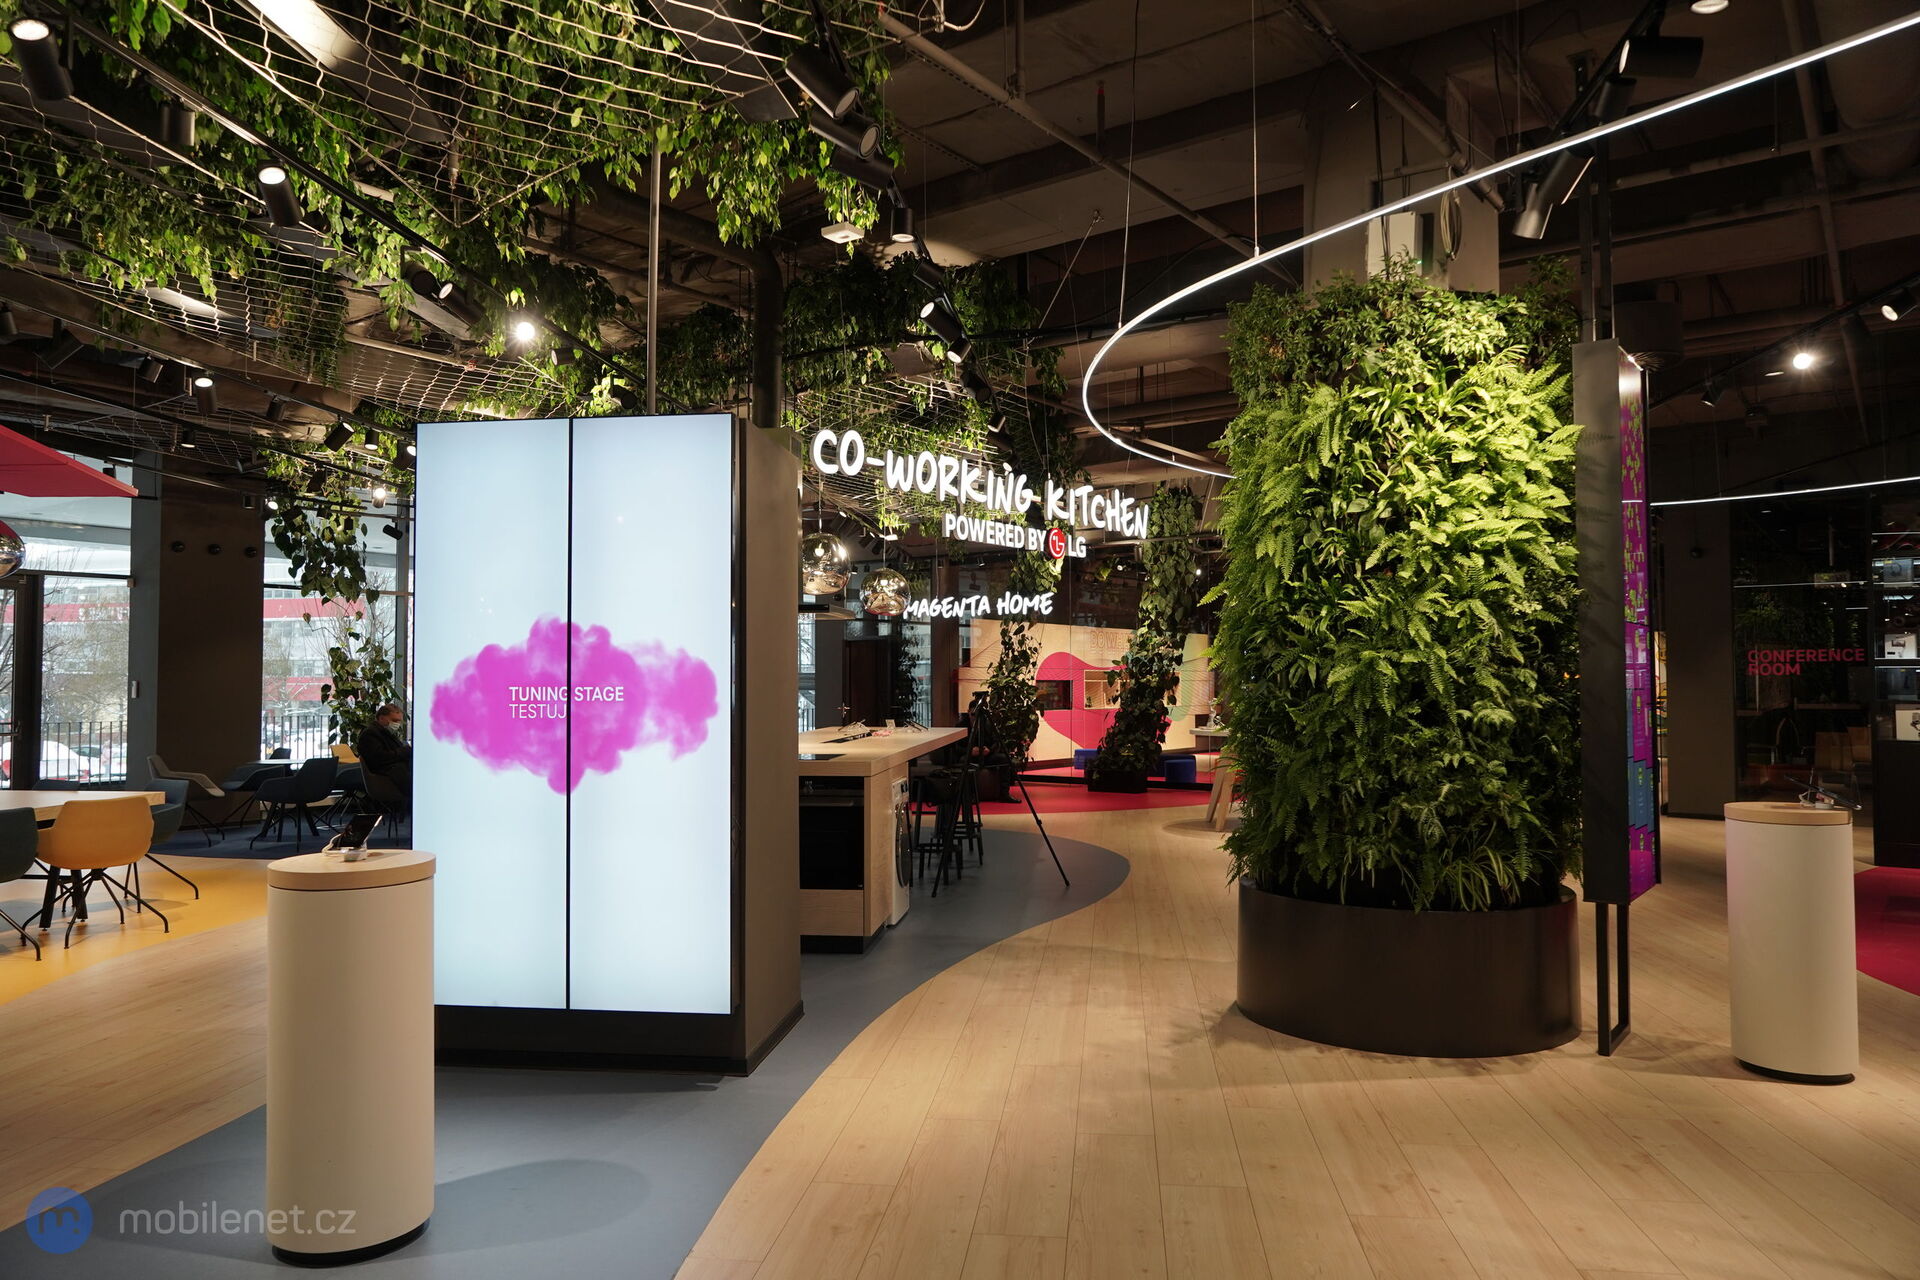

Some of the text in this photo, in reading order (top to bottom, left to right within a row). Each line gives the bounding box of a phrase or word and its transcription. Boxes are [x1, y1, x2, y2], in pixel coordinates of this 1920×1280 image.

[810, 429, 1150, 540] CO-WORKING KITCHEN
[943, 513, 1025, 549] POWERED
[1026, 527, 1047, 551] BY
[1067, 534, 1087, 558] LG
[902, 591, 1055, 620] MAGENTA HOME
[1747, 648, 1865, 663] CONFERENCE
[1747, 663, 1801, 676] ROOM
[508, 686, 624, 702] TUNING STAGE
[508, 703, 567, 719] TESTUJ
